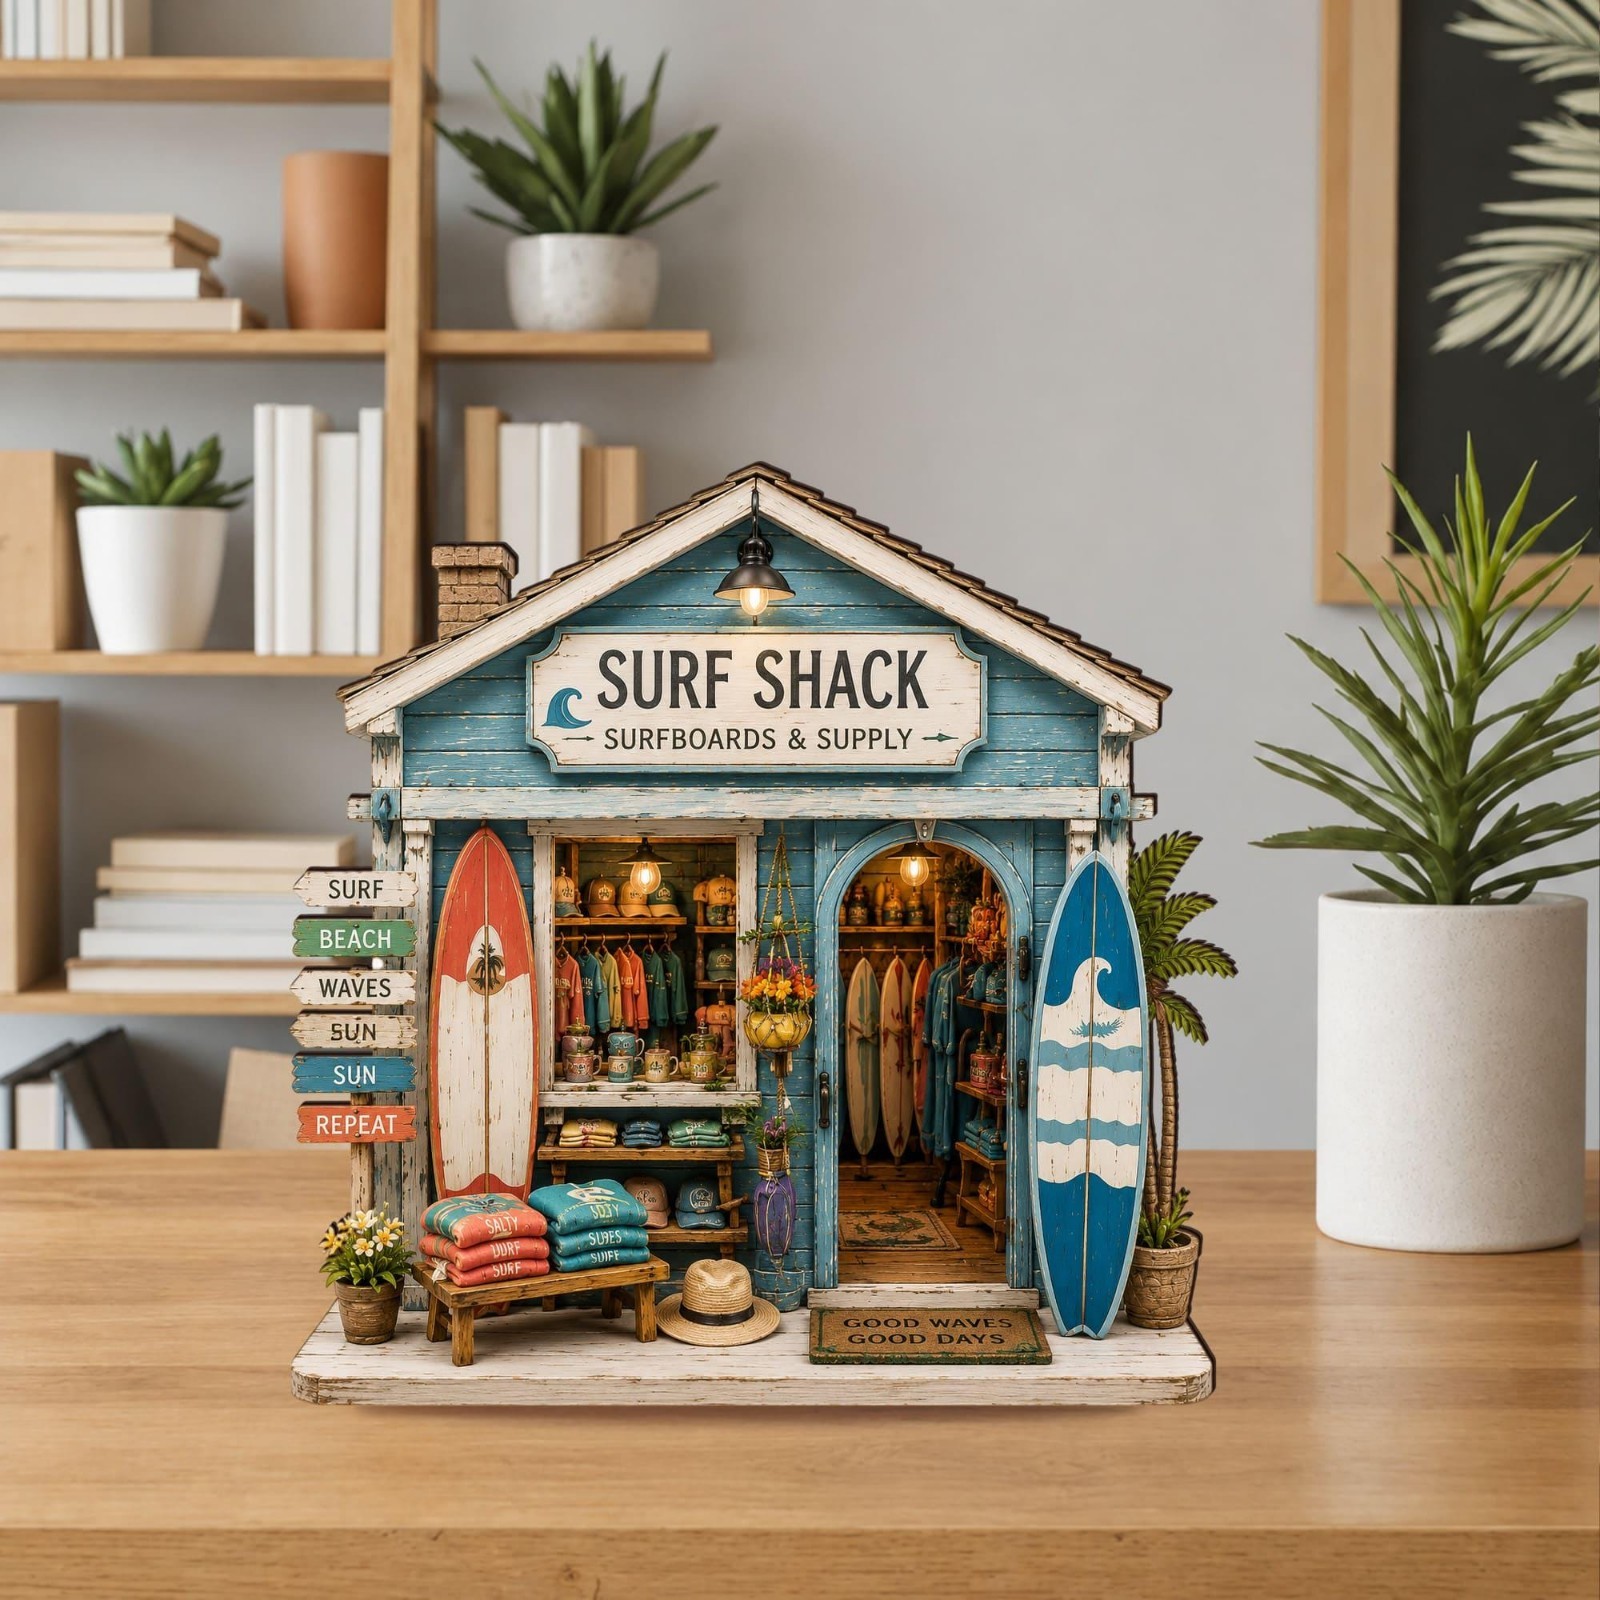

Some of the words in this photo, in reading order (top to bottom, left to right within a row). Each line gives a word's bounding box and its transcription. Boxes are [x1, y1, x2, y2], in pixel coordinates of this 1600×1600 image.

[597, 649, 733, 710] SURF
[754, 649, 929, 710] SHACK
[604, 728, 776, 750] SURFBOARDS
[787, 728, 807, 750] &
[817, 728, 913, 750] SUPPLY
[328, 879, 384, 899] SURF
[319, 929, 391, 949] BEACH
[319, 978, 391, 998] WAVES
[331, 1023, 376, 1041] SUN
[333, 1065, 376, 1085] SUN
[316, 1115, 397, 1135] REPEAT
[485, 1216, 518, 1235] SALTY
[492, 1261, 522, 1278] SURF
[843, 1318, 919, 1328] GOOD
[929, 1318, 1012, 1328] WAVES
[848, 1333, 926, 1345] GOOD
[937, 1333, 1005, 1345] DAYS
